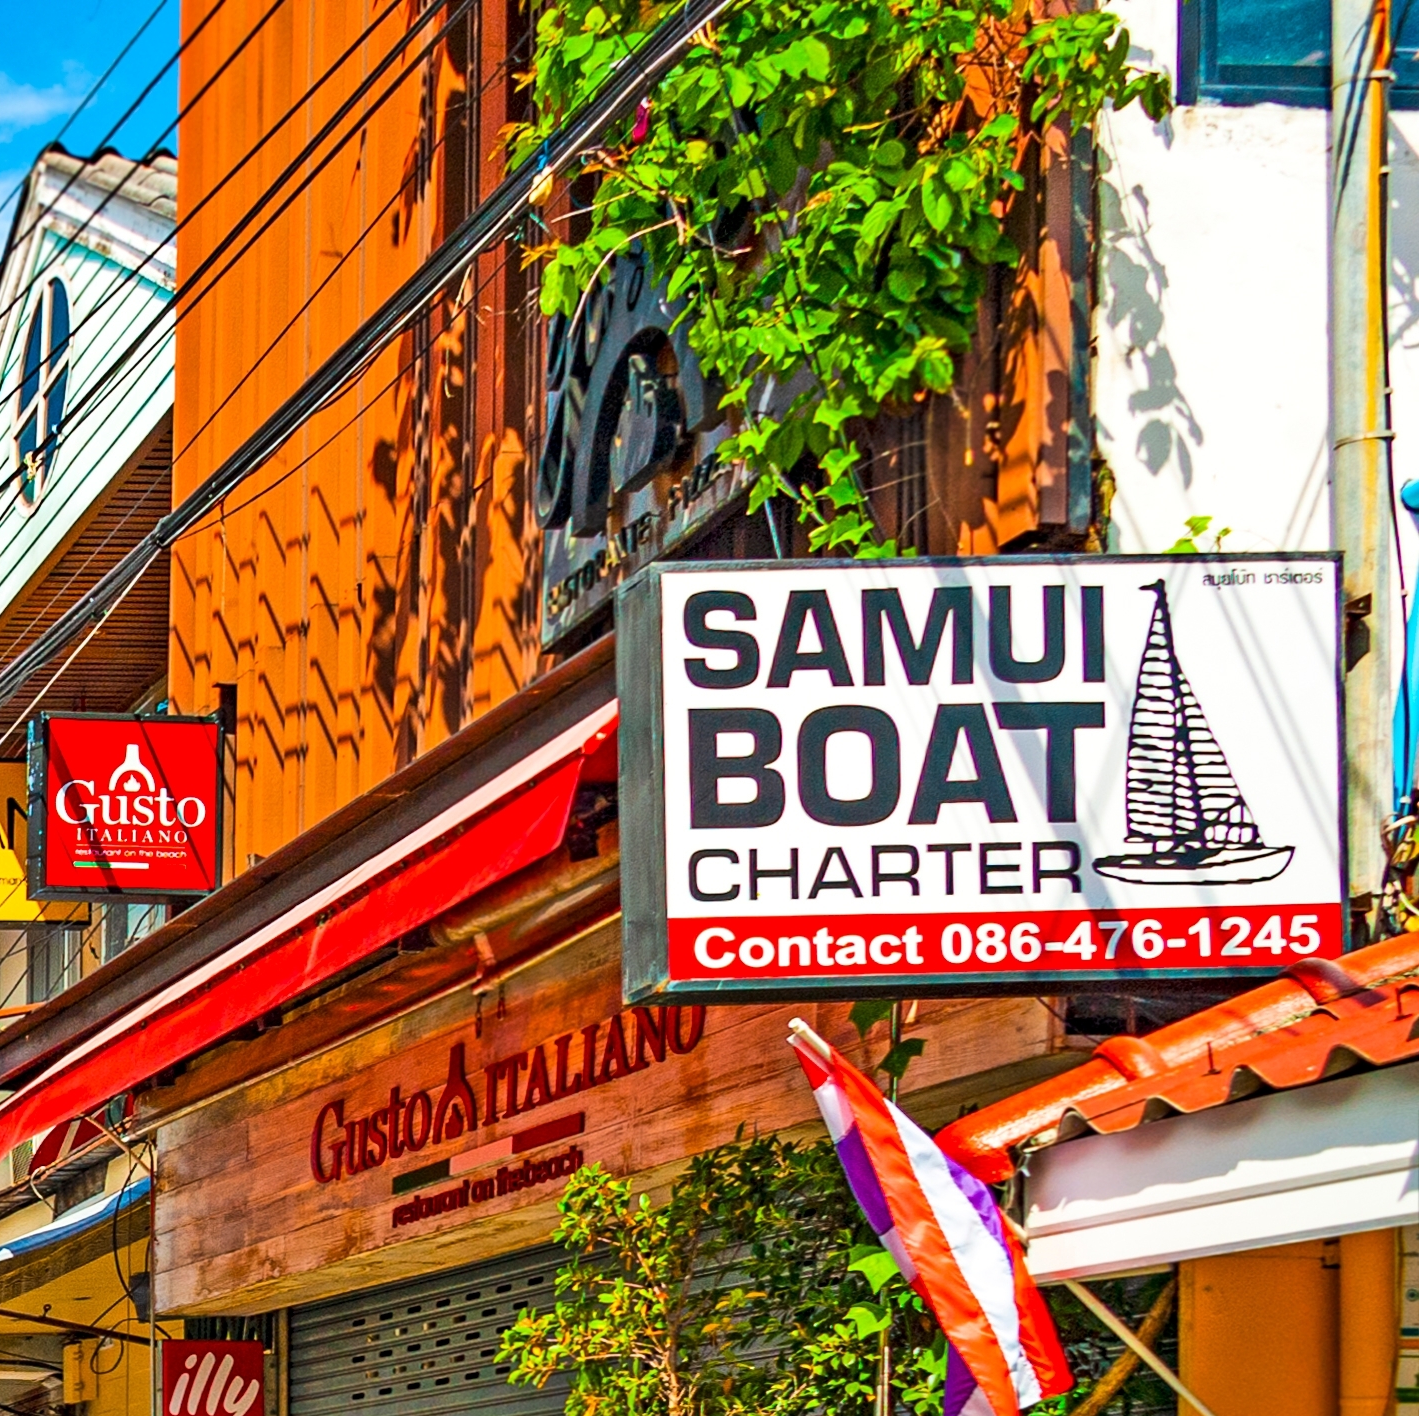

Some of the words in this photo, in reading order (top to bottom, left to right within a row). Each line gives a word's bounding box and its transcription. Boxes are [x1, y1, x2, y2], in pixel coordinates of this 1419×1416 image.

[683, 584, 1105, 690] SAMUI
[688, 701, 1105, 831] BOAT
[55, 780, 206, 828] Gusto
[74, 848, 122, 857] restaurant
[139, 849, 154, 857] the
[156, 850, 187, 858] beach
[76, 827, 188, 844] ITALIANO
[688, 841, 1083, 903] CHARTER
[693, 925, 925, 970] Contact
[939, 913, 1322, 965] 086-476-1245
[310, 1086, 432, 1184] Gusto
[481, 1004, 707, 1127] ITALIANO
[391, 1179, 470, 1229] restaurant
[471, 1177, 495, 1204] on
[496, 1166, 523, 1197] the
[523, 1145, 584, 1188] beach
